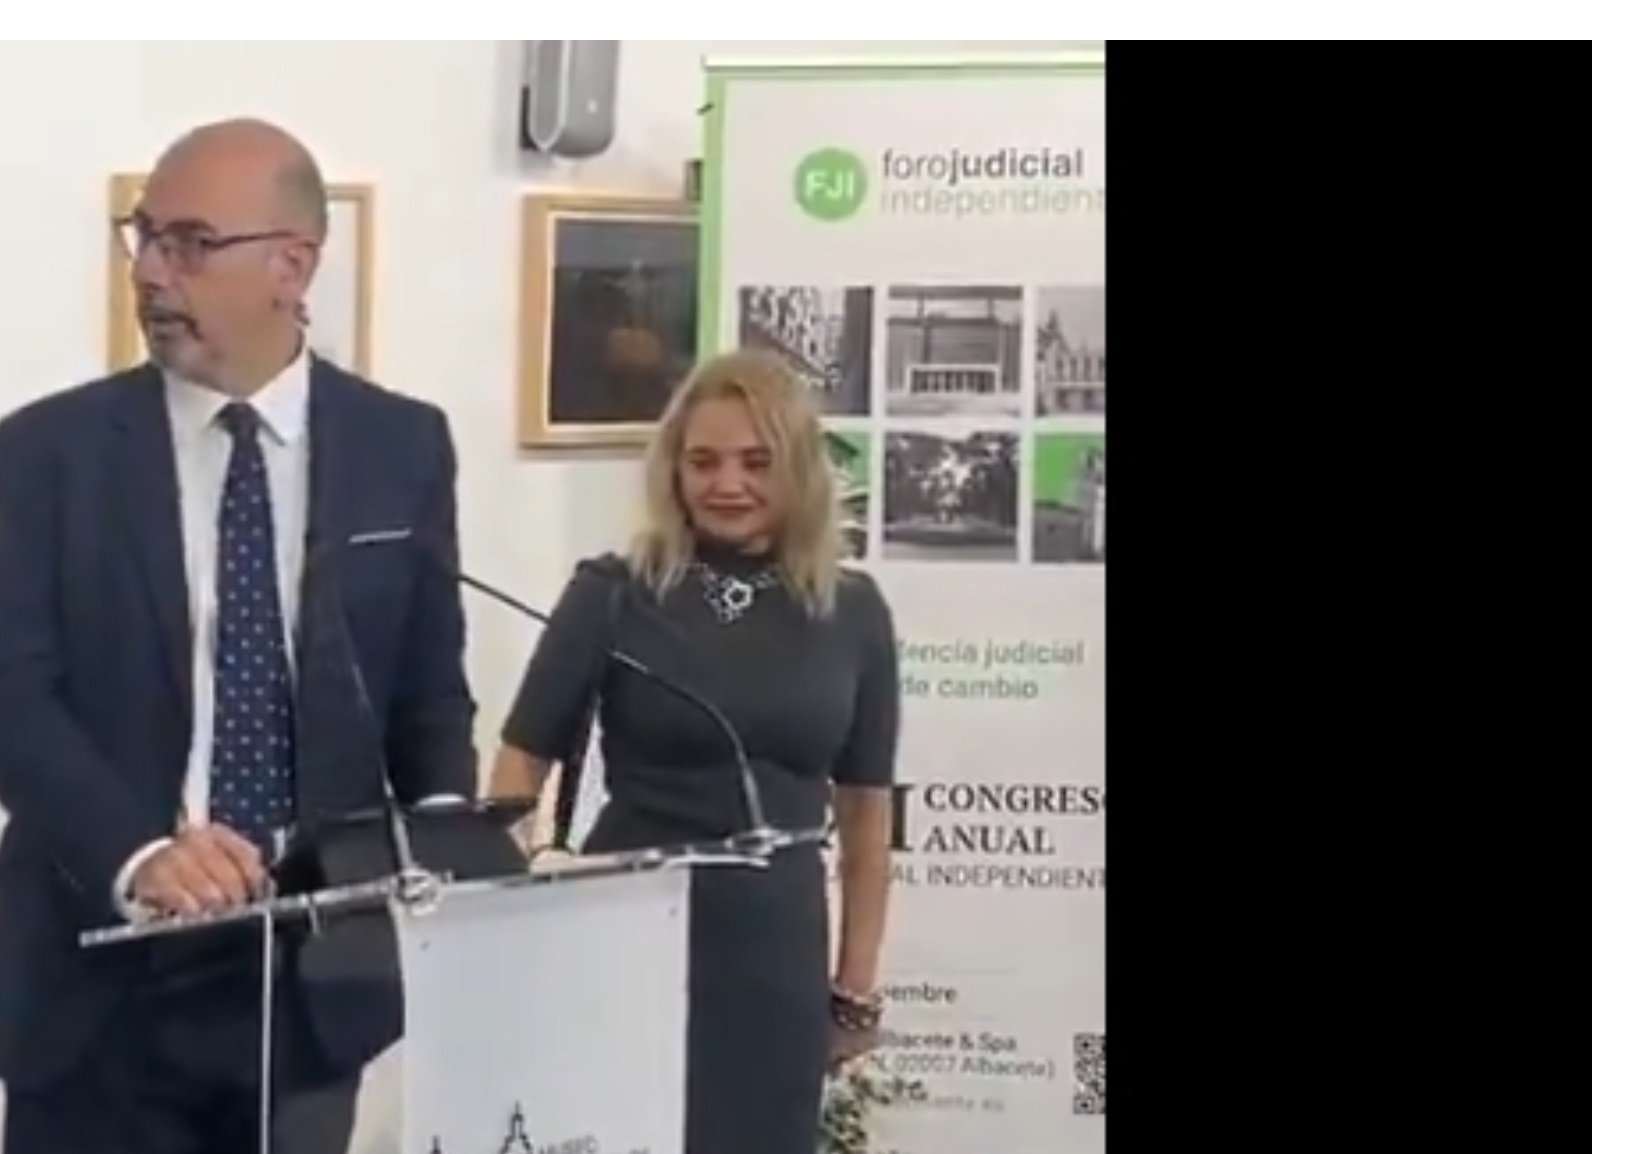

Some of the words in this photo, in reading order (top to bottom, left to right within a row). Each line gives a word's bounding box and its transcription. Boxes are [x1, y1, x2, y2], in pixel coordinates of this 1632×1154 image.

[883, 147, 1083, 187] forojudicial
[806, 170, 855, 199] FJI
[984, 639, 1085, 669] judicial
[937, 677, 1039, 700] cambio
[923, 782, 1105, 815] CONGRES
[923, 825, 1056, 855] ANUAL
[979, 1033, 1017, 1053] Spa
